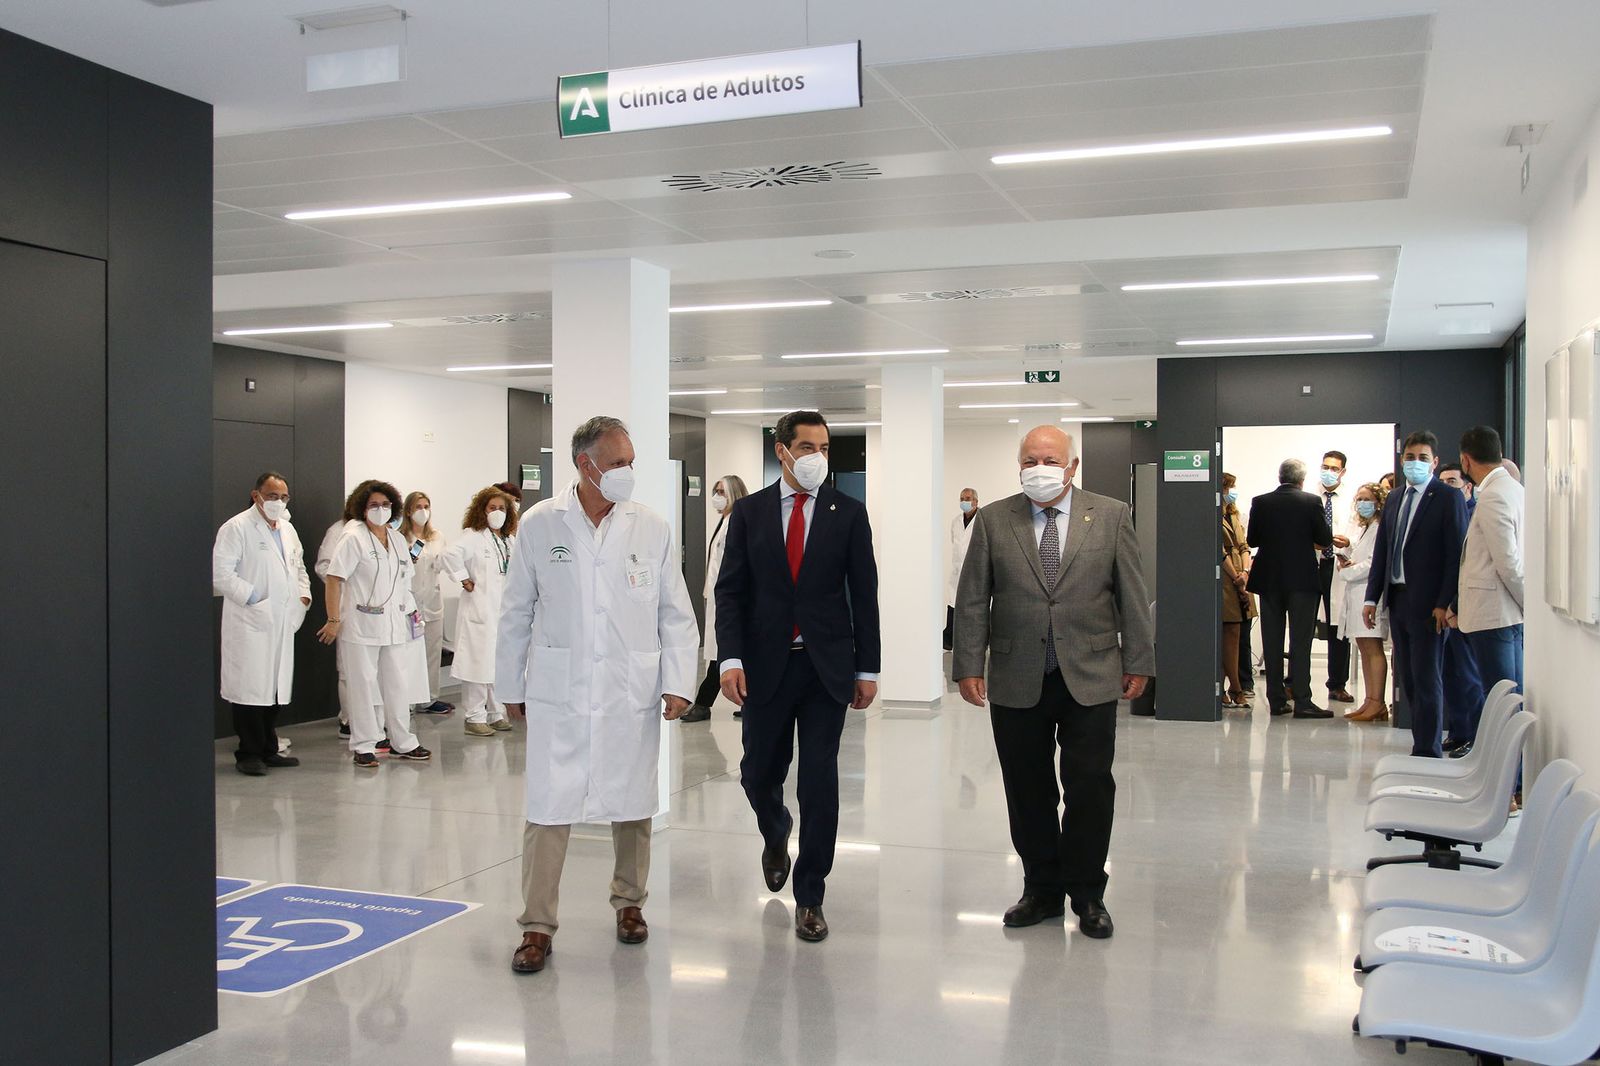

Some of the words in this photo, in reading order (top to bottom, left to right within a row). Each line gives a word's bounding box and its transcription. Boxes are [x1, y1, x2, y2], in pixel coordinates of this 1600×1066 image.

[619, 86, 687, 109] Clínica
[693, 81, 718, 101] de
[724, 74, 805, 98] Adultos
[1192, 454, 1202, 468] 8
[283, 895, 361, 909] Reservado
[363, 904, 423, 916] Espacio
